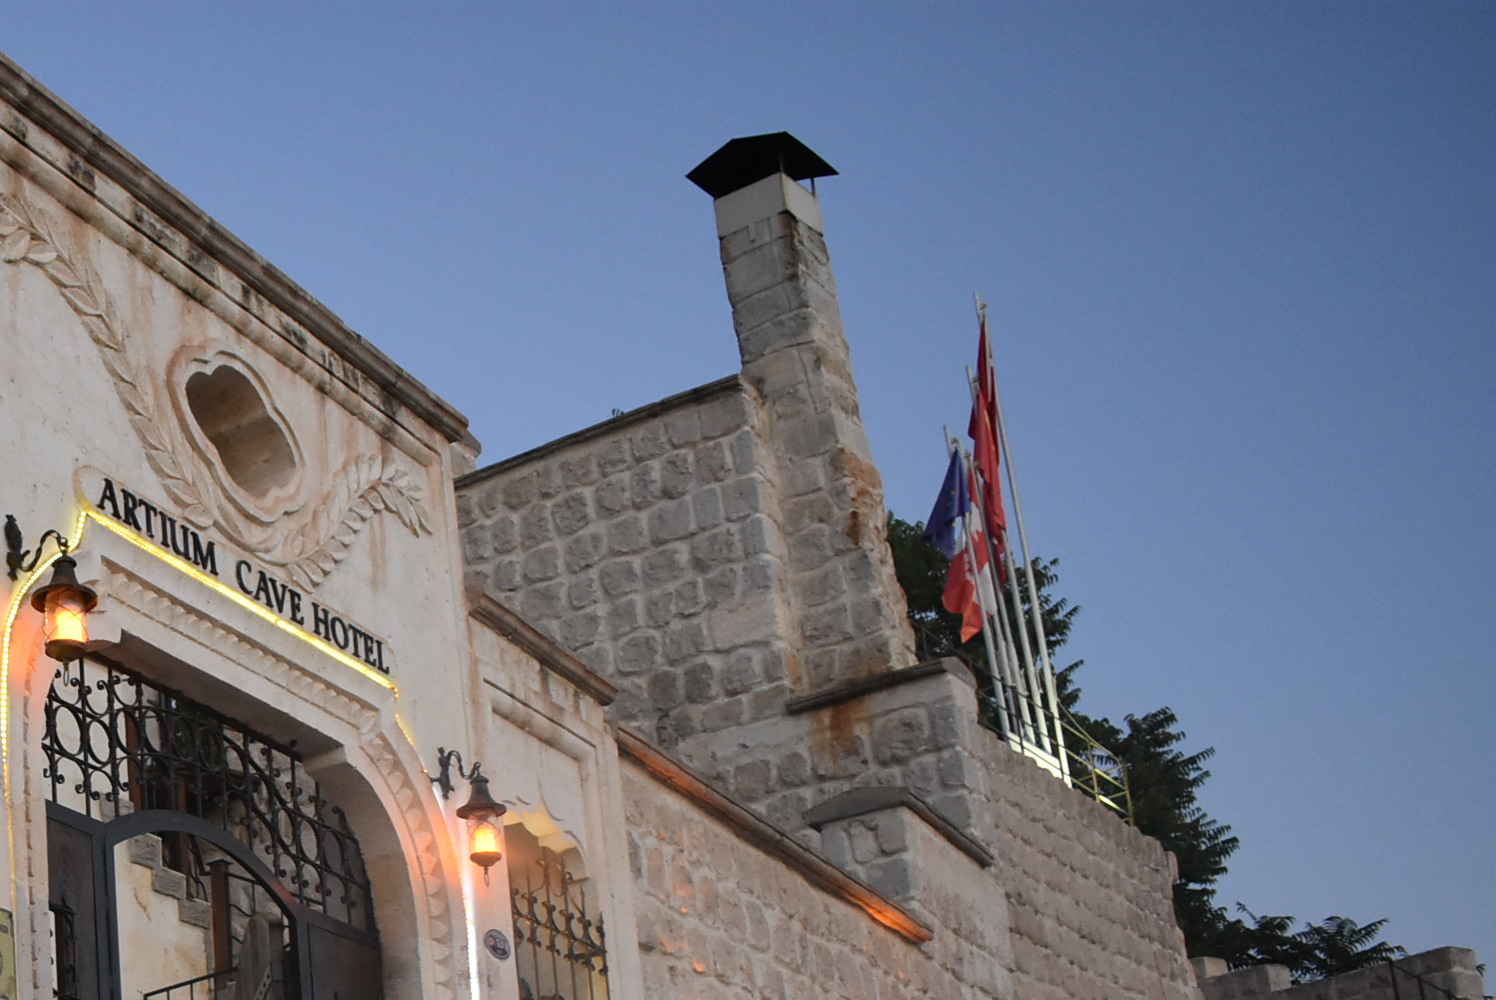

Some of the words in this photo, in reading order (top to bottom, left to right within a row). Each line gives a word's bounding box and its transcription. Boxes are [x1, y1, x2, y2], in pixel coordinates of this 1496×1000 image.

[96, 478, 219, 576] ARTIUM
[236, 560, 304, 626] CAVE
[311, 602, 390, 675] HOTEL
